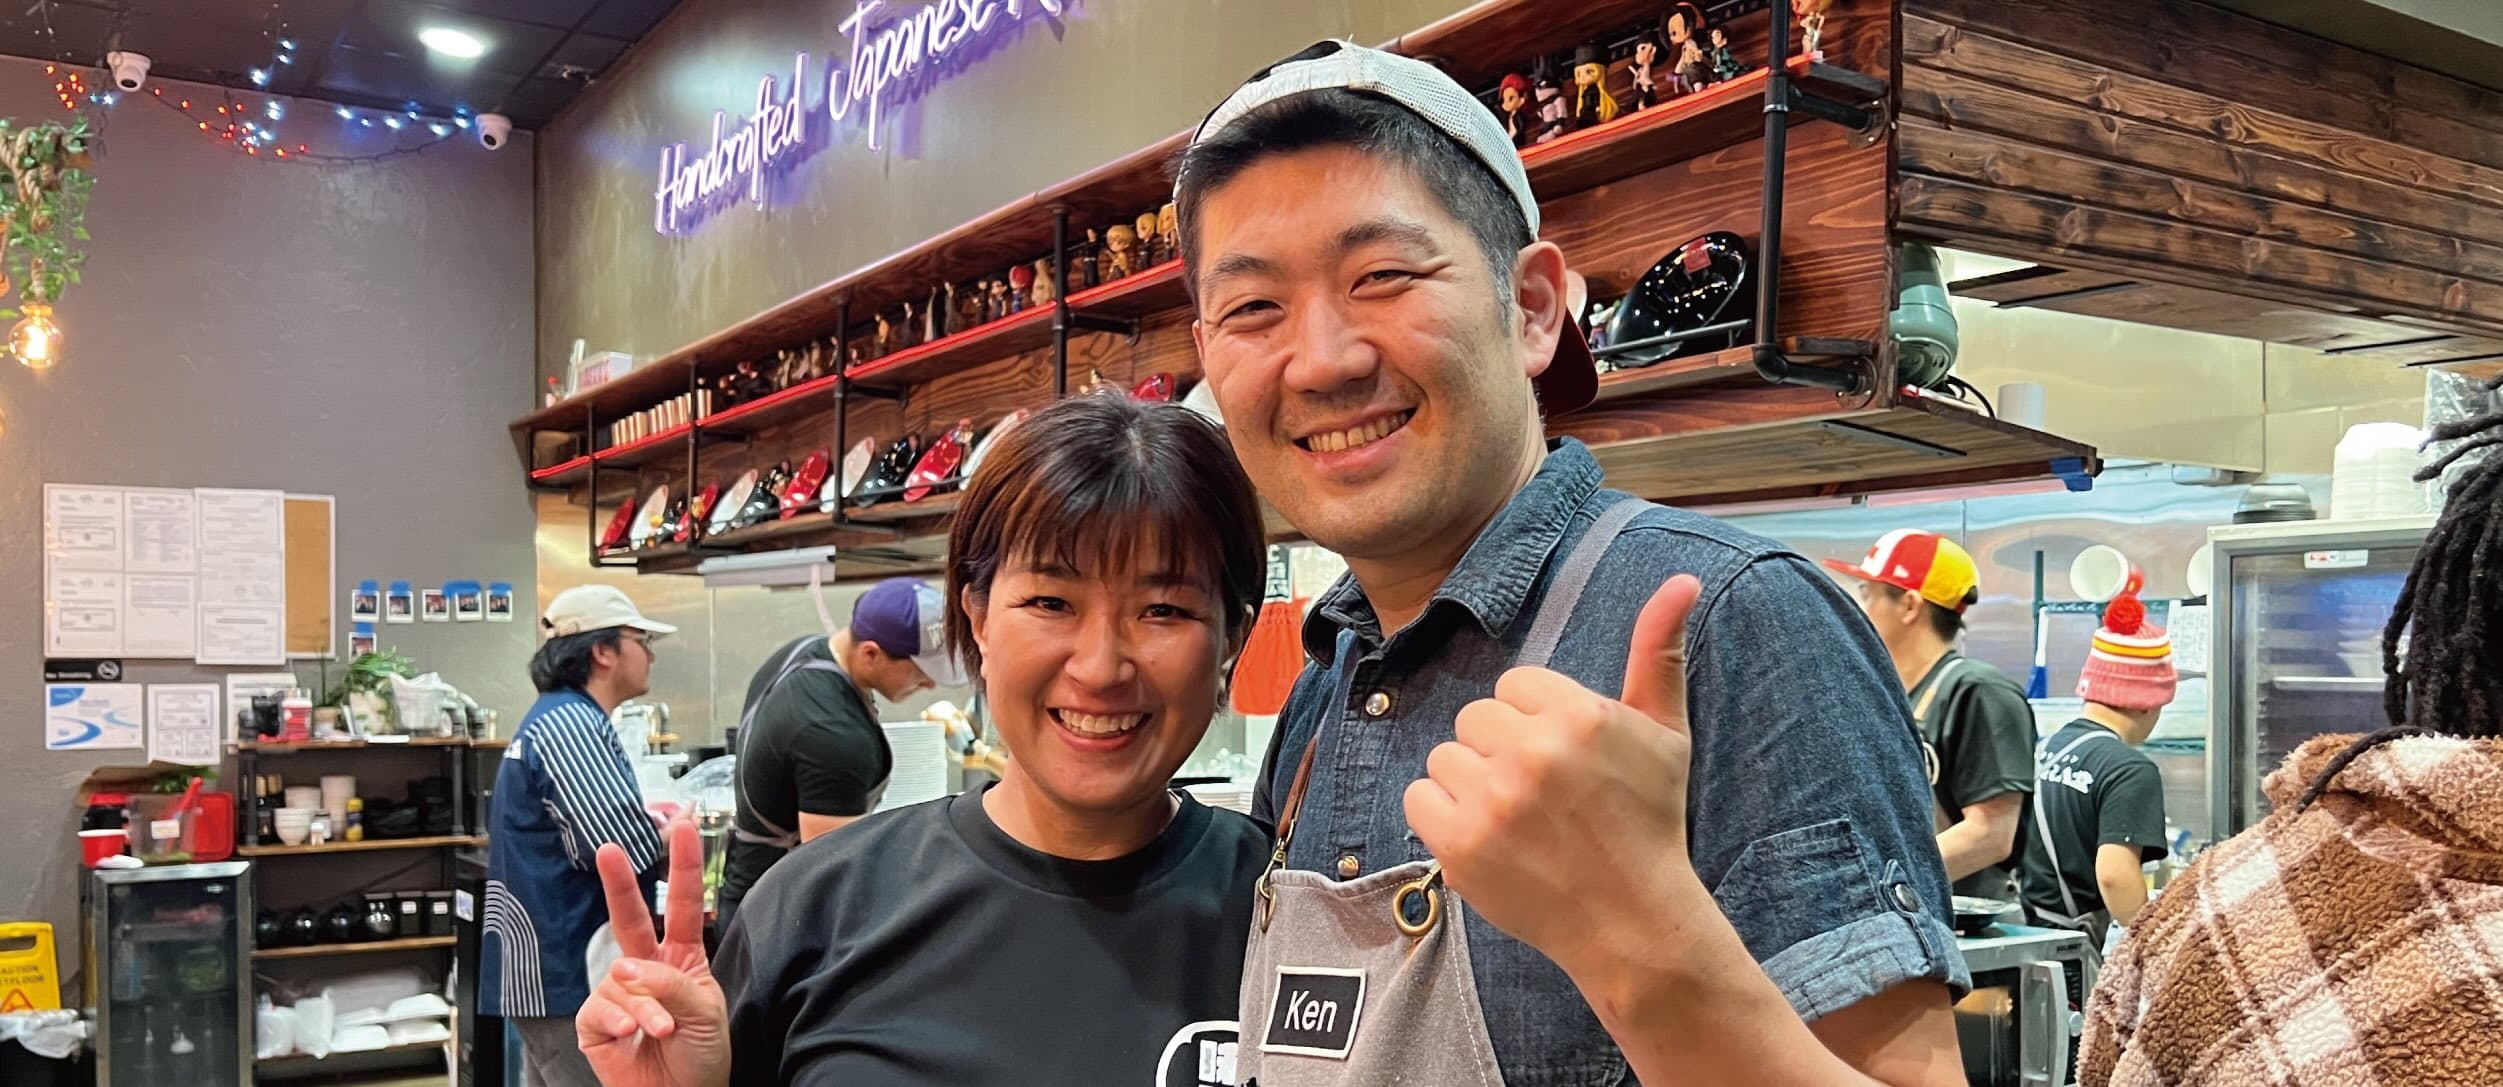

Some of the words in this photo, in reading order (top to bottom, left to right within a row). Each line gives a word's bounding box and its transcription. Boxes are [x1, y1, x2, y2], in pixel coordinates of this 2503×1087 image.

[655, 52, 808, 234] Handcrafted
[829, 0, 997, 151] Japanese
[1284, 990, 1338, 1033] Ken
